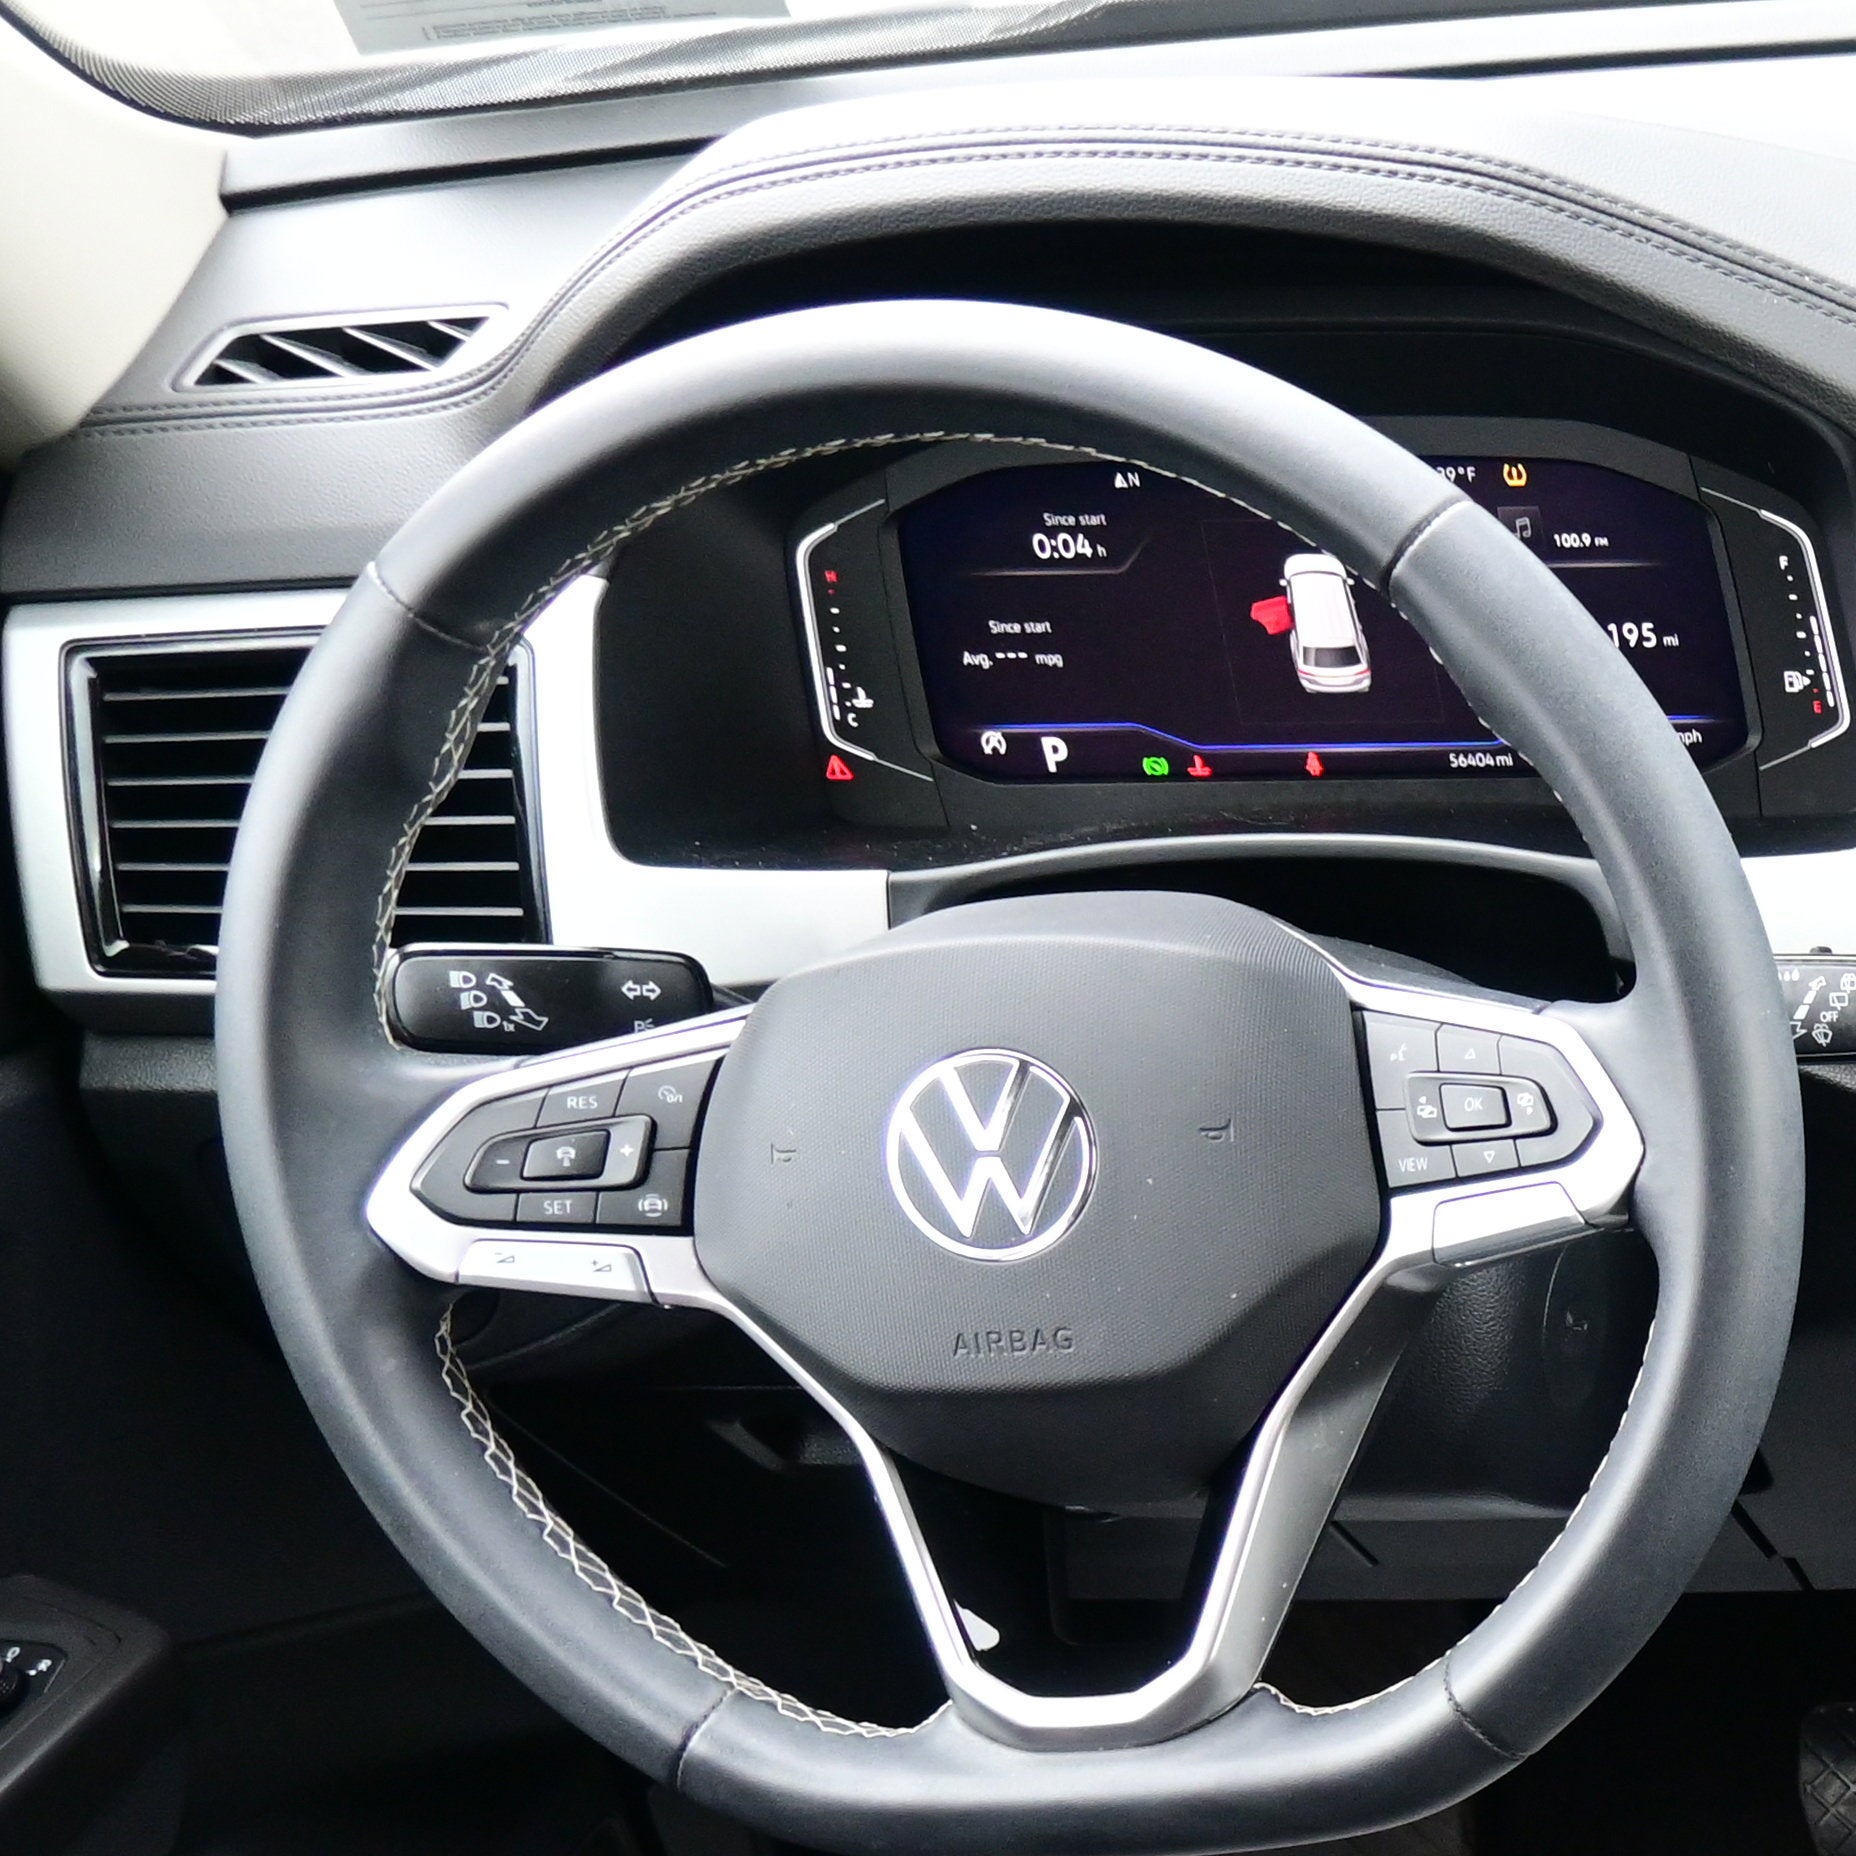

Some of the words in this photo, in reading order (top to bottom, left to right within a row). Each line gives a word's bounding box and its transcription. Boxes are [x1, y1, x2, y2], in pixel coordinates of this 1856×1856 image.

[1043, 513, 1075, 526] Since
[1079, 513, 1106, 526] start
[1032, 532, 1093, 559] 0:04
[1098, 544, 1107, 558] h
[1553, 533, 1591, 548] 100.9
[988, 620, 1021, 634] Since
[1024, 620, 1052, 633] start
[1663, 633, 1679, 646] mi
[962, 650, 993, 669] Avg.
[1035, 653, 1063, 667] mpg
[1041, 736, 1068, 773] P
[1449, 753, 1494, 767] 56404
[1496, 752, 1513, 766] mi
[1820, 1011, 1839, 1023] OFF
[567, 1096, 598, 1109] RES
[1464, 1097, 1483, 1112] OK
[1399, 1158, 1428, 1172] VIEW
[543, 1200, 572, 1215] SET
[953, 1326, 1074, 1358] AIRBAG
